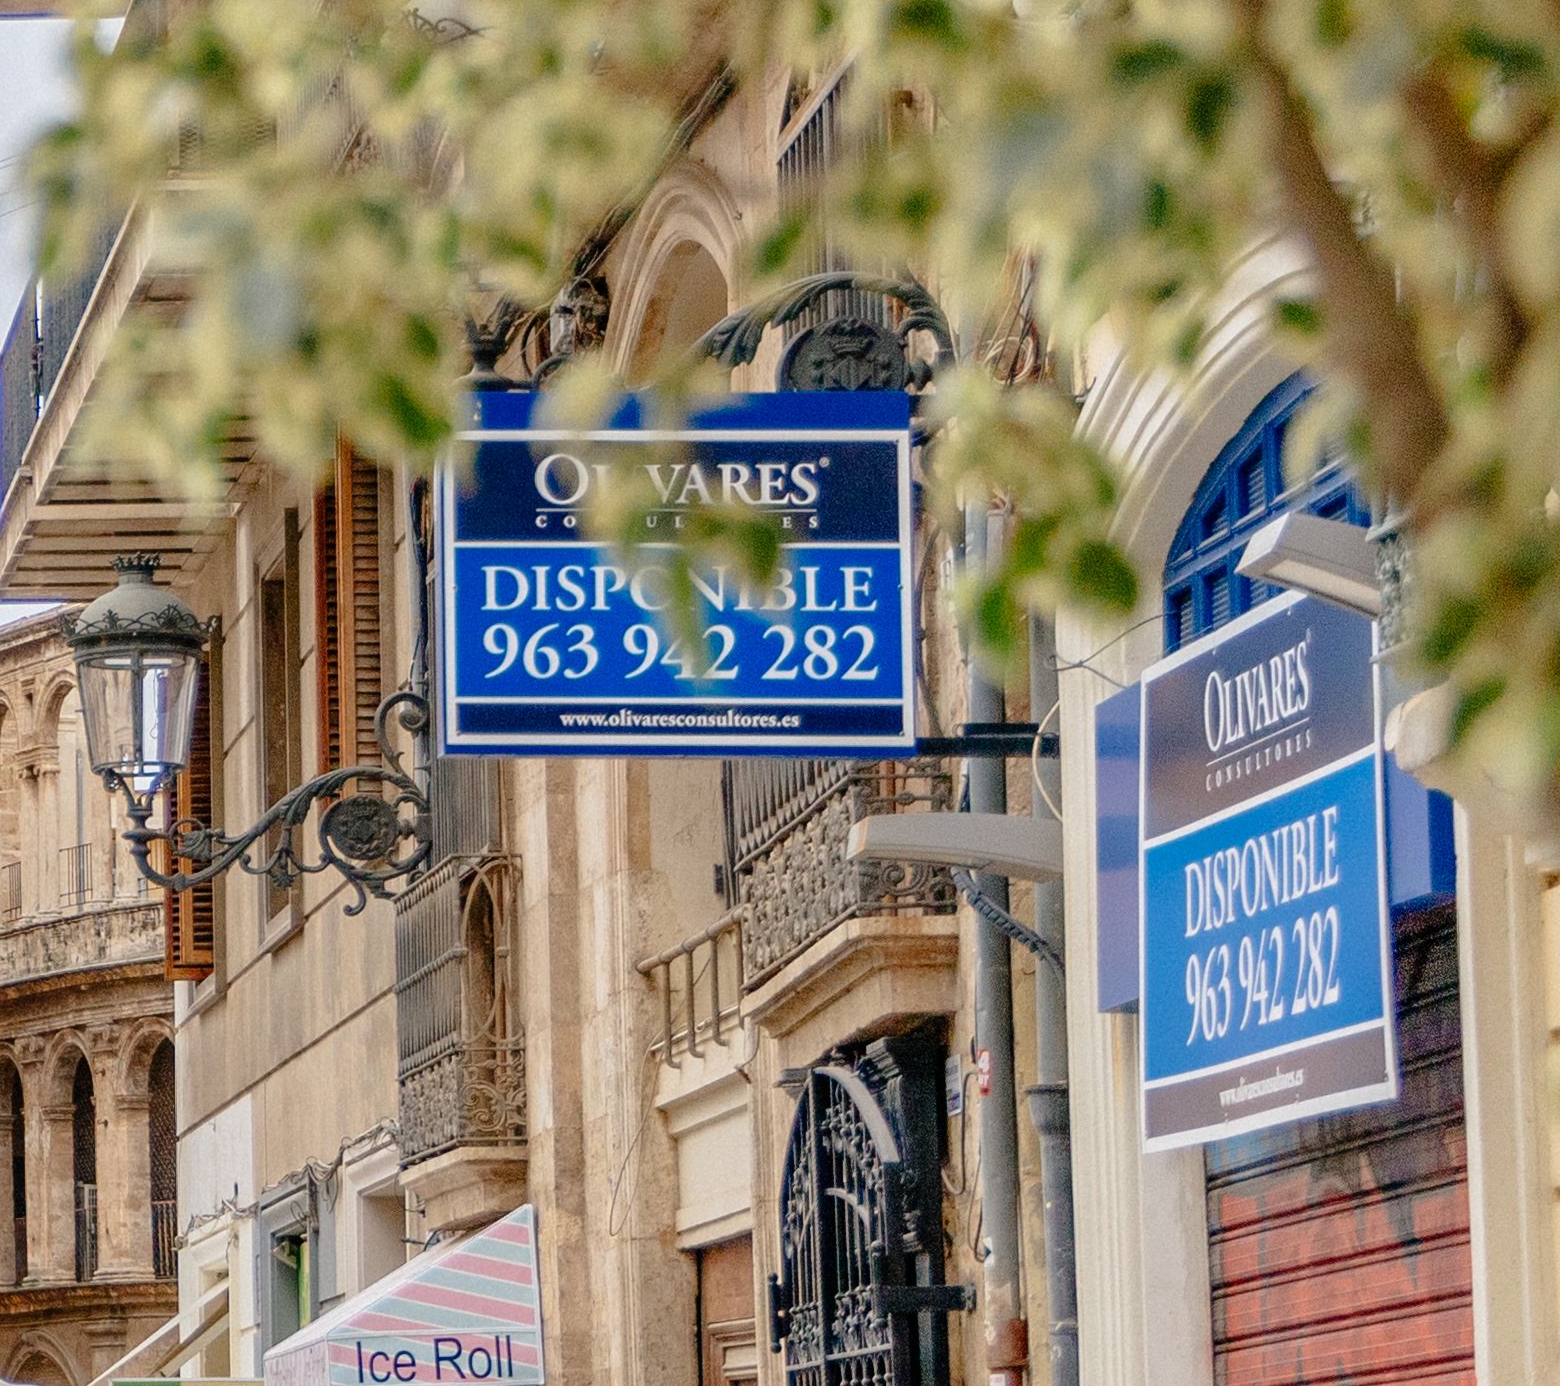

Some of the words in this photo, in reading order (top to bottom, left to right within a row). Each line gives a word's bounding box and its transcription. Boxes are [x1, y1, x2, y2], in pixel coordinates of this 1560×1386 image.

[535, 515, 819, 528] COULES
[483, 623, 599, 680] 963
[623, 623, 739, 680] 942
[762, 624, 879, 680] 282
[559, 709, 801, 729] www.olivaresconsultores.es
[1204, 641, 1310, 752] OLIVARES
[1206, 728, 1311, 792] CONSULTORES
[1184, 805, 1339, 938] DISPONIBLE
[1186, 944, 1232, 1046] 963
[1239, 926, 1284, 1031] 942
[1291, 906, 1340, 1015] 282
[356, 1340, 417, 1383] Ice
[433, 1334, 513, 1380] Roll
